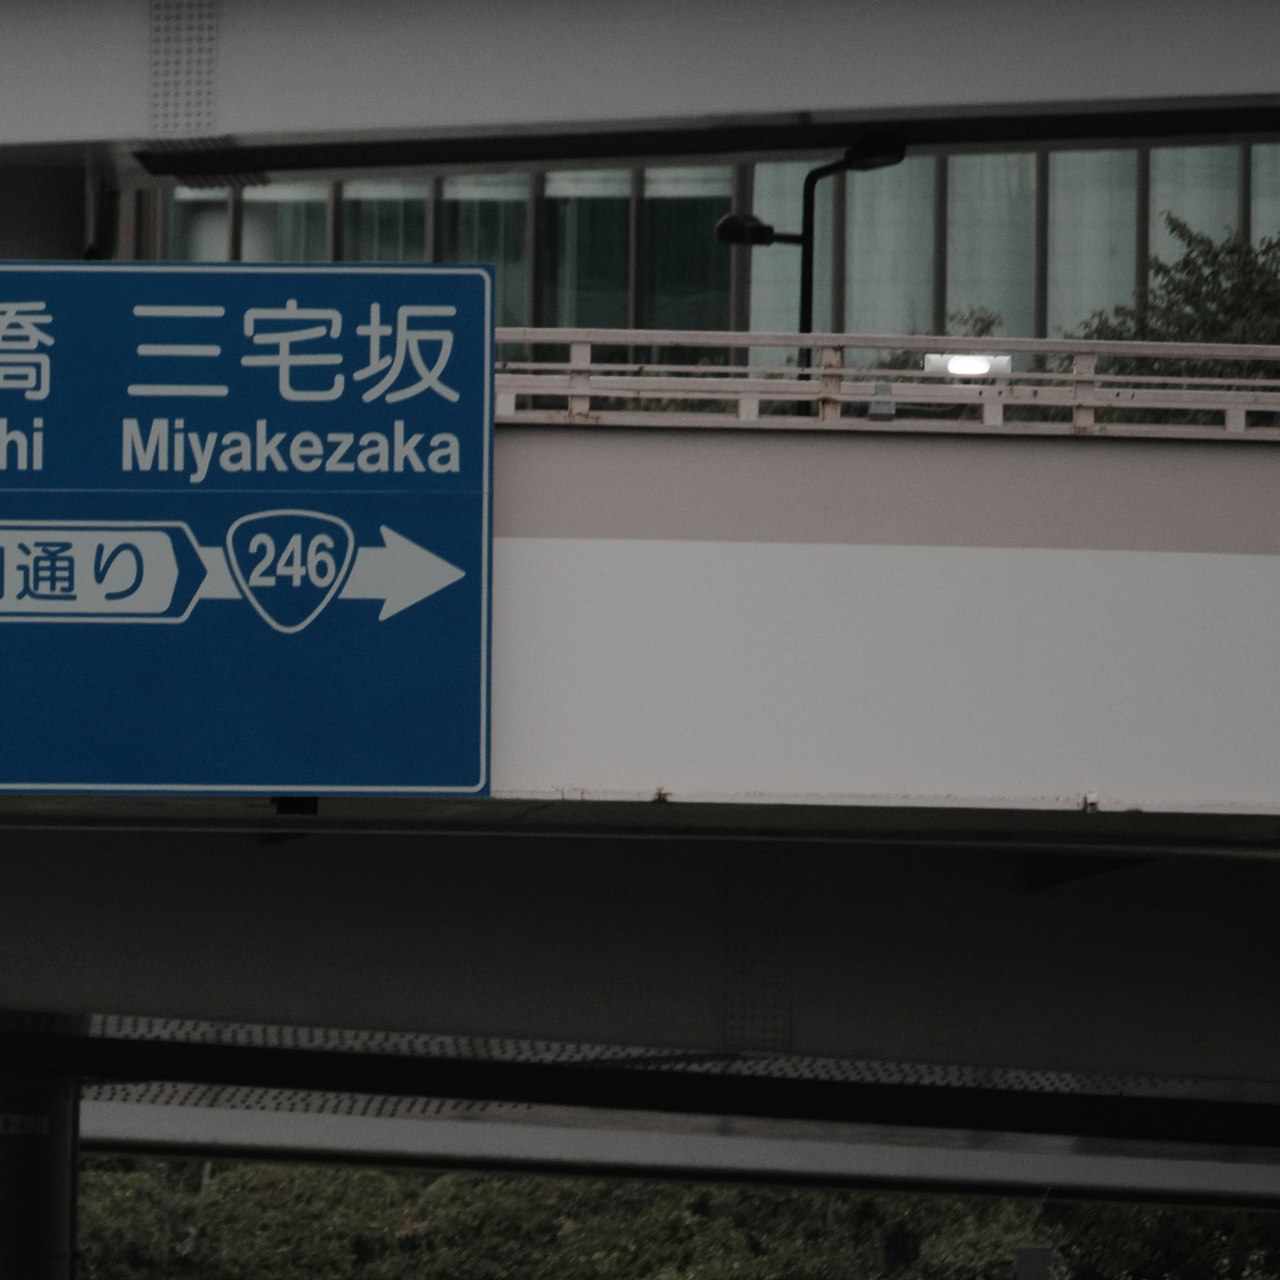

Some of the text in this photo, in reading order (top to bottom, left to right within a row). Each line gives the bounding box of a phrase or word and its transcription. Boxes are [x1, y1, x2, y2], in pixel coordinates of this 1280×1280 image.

[127, 298, 460, 403] 三宅坂
[122, 418, 460, 483] Miyakezaka
[248, 531, 337, 588] 246
